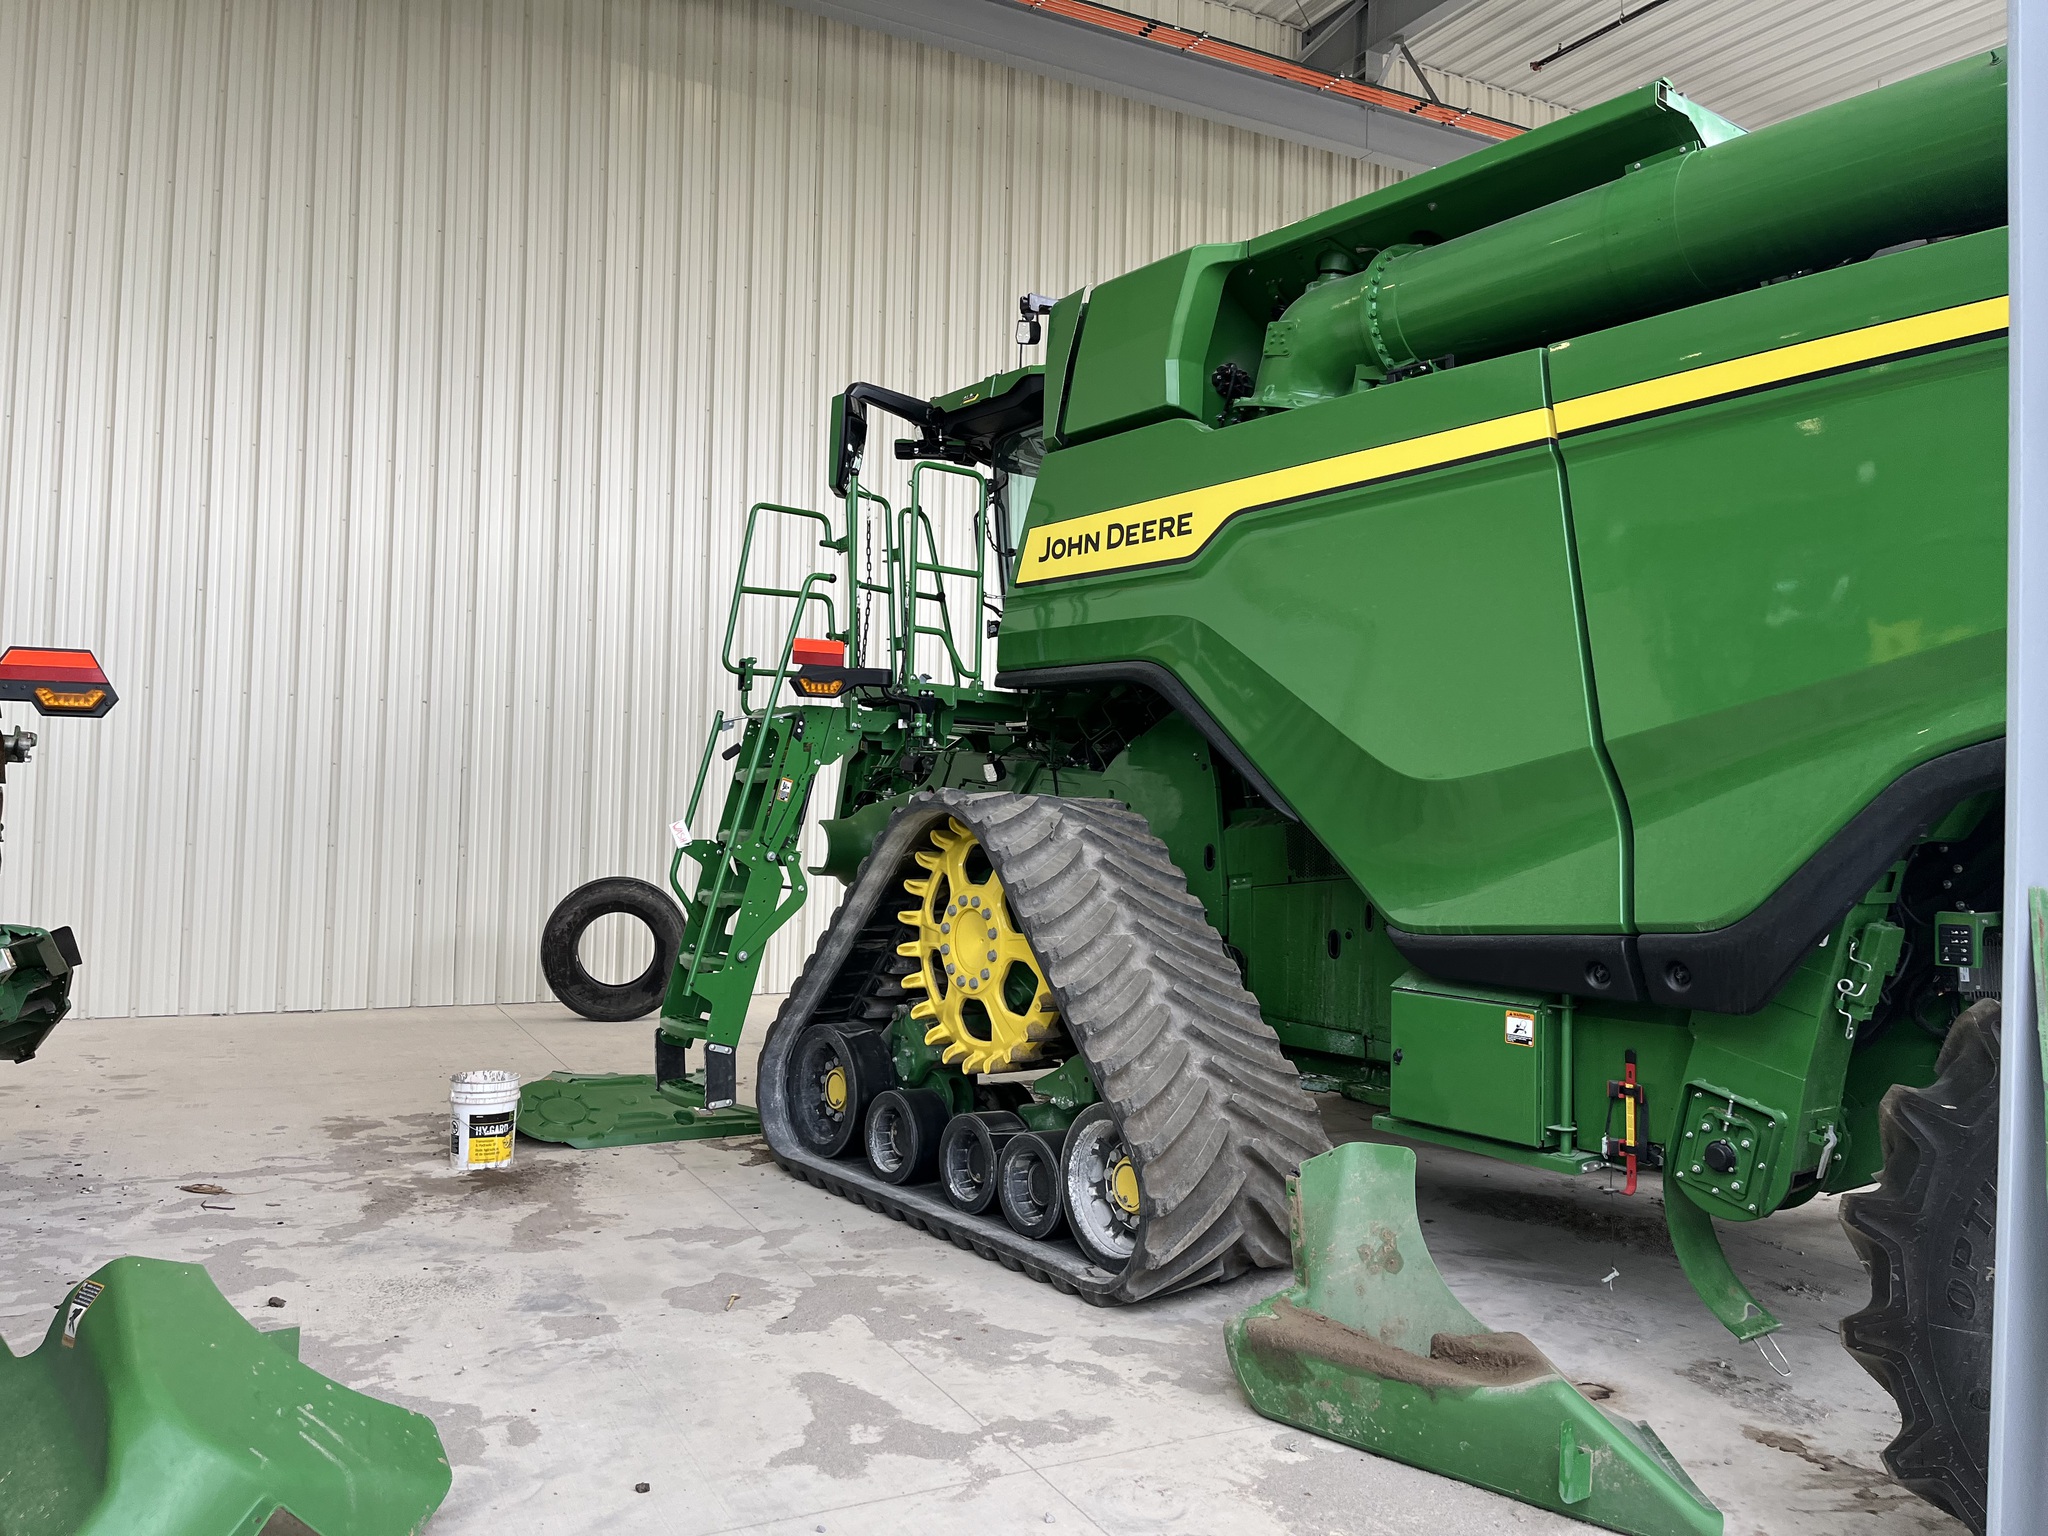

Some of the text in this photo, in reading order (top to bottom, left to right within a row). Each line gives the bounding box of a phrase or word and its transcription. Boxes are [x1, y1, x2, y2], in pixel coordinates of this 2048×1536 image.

[1038, 512, 1193, 563] JOHN DEERE
[672, 821, 688, 844] WASH
